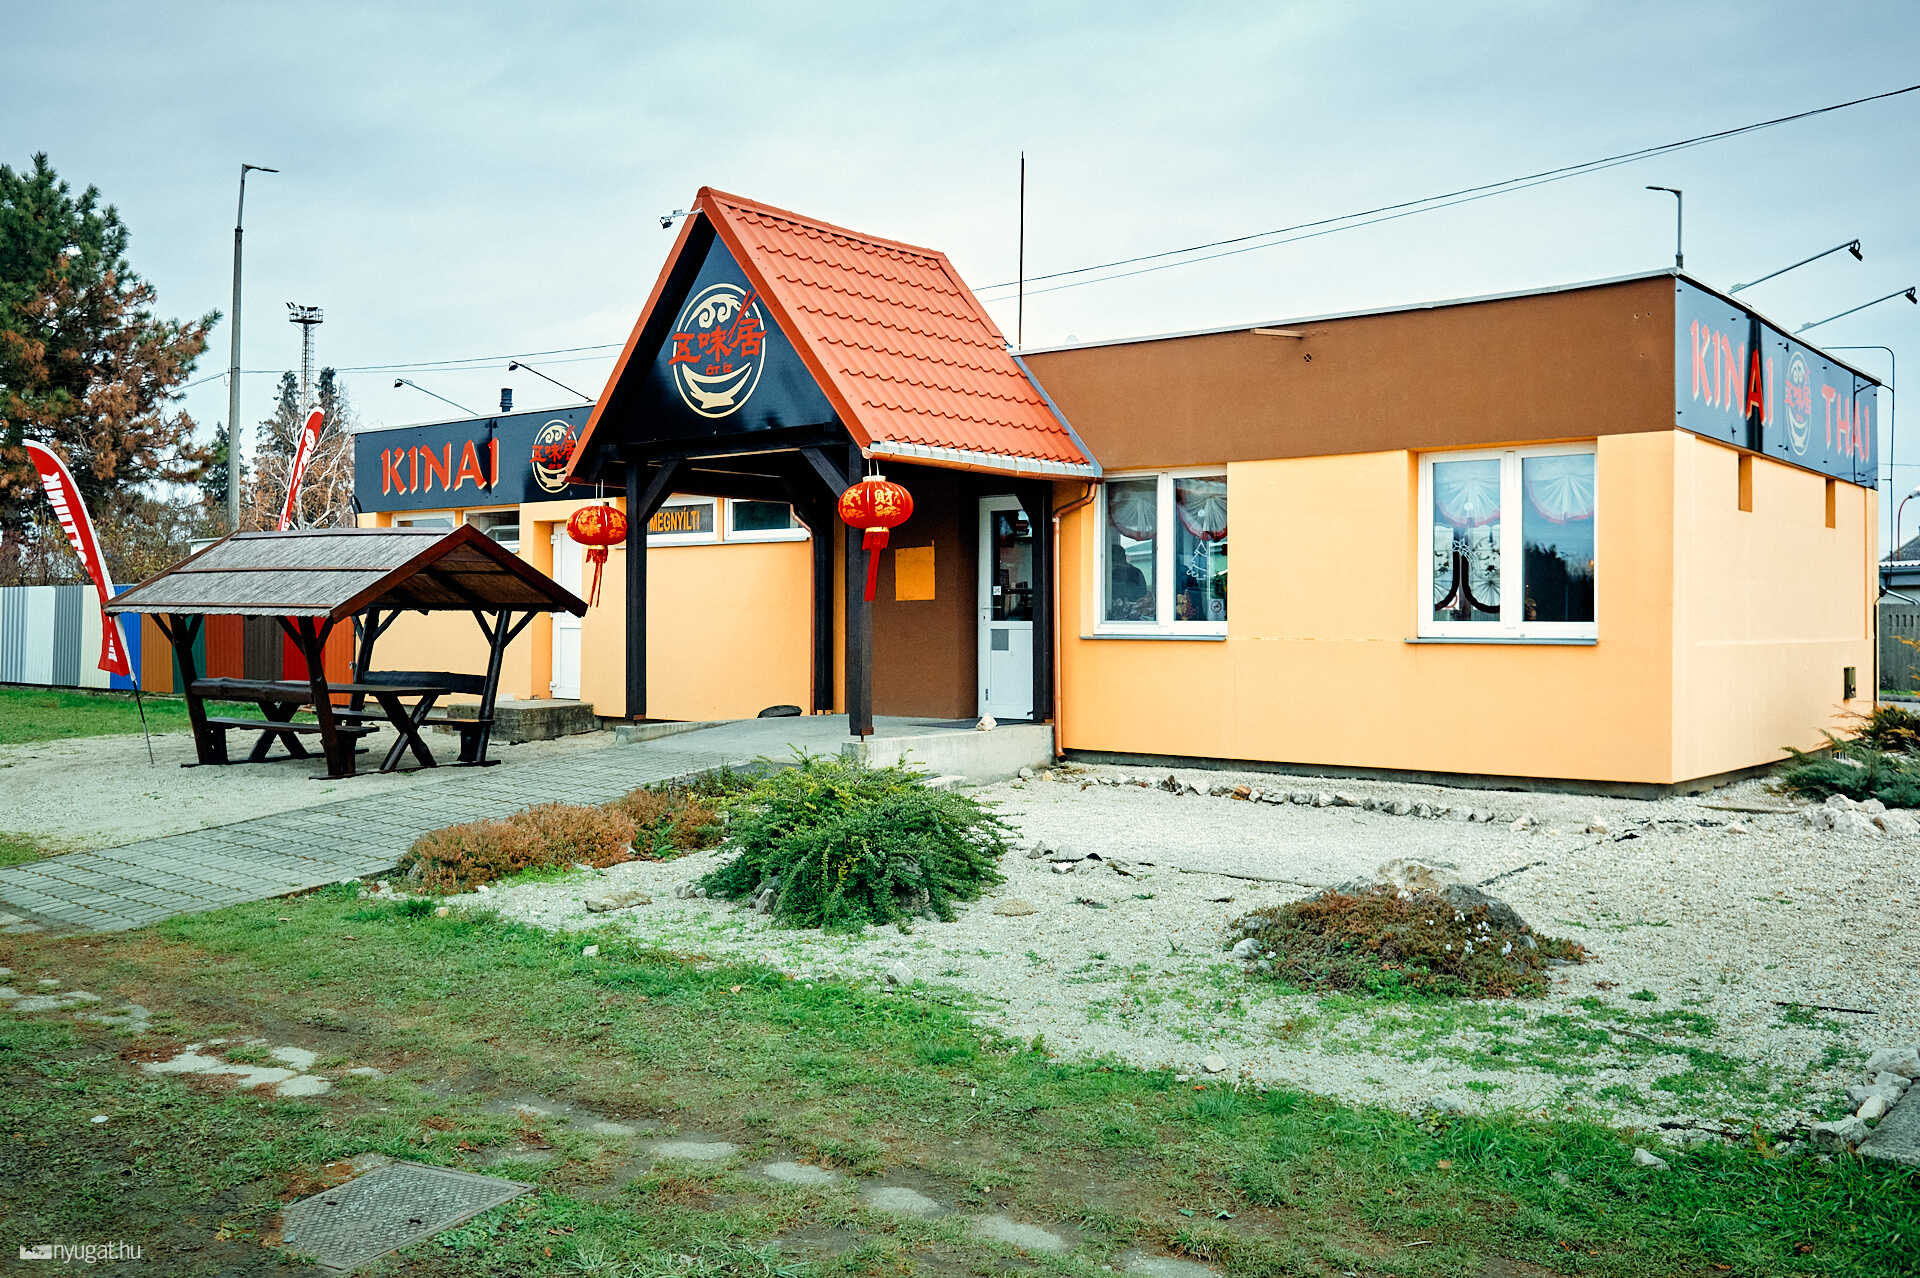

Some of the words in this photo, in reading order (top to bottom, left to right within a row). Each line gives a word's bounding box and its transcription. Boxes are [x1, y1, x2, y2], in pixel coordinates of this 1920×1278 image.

[669, 319, 767, 365] 五味居
[1691, 320, 1774, 428] KINAI
[1822, 384, 1869, 464] THAI
[381, 437, 500, 496] KINAI
